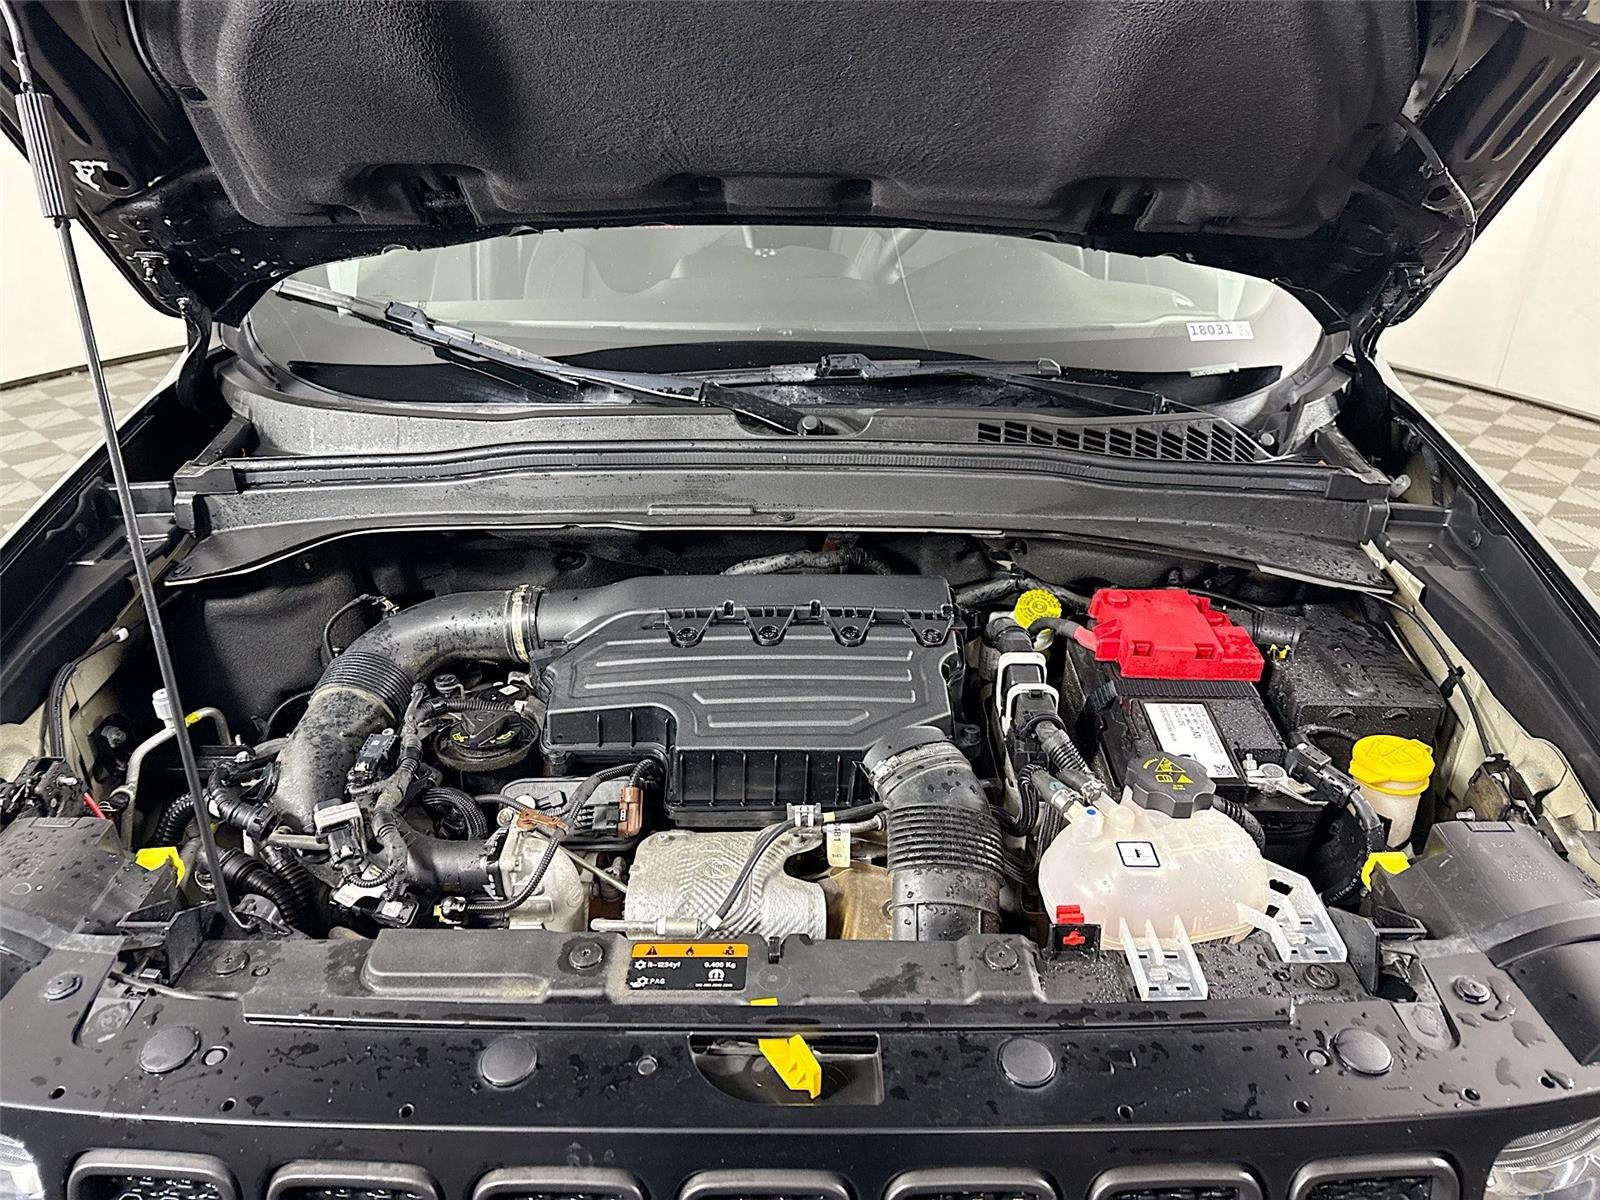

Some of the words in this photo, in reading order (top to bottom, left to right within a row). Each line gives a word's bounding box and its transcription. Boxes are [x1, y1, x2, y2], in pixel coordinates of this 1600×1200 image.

[1189, 324, 1233, 336] 18031
[647, 961, 681, 970] R-1234yf
[725, 961, 737, 969] Kg
[649, 977, 666, 985] PAG
